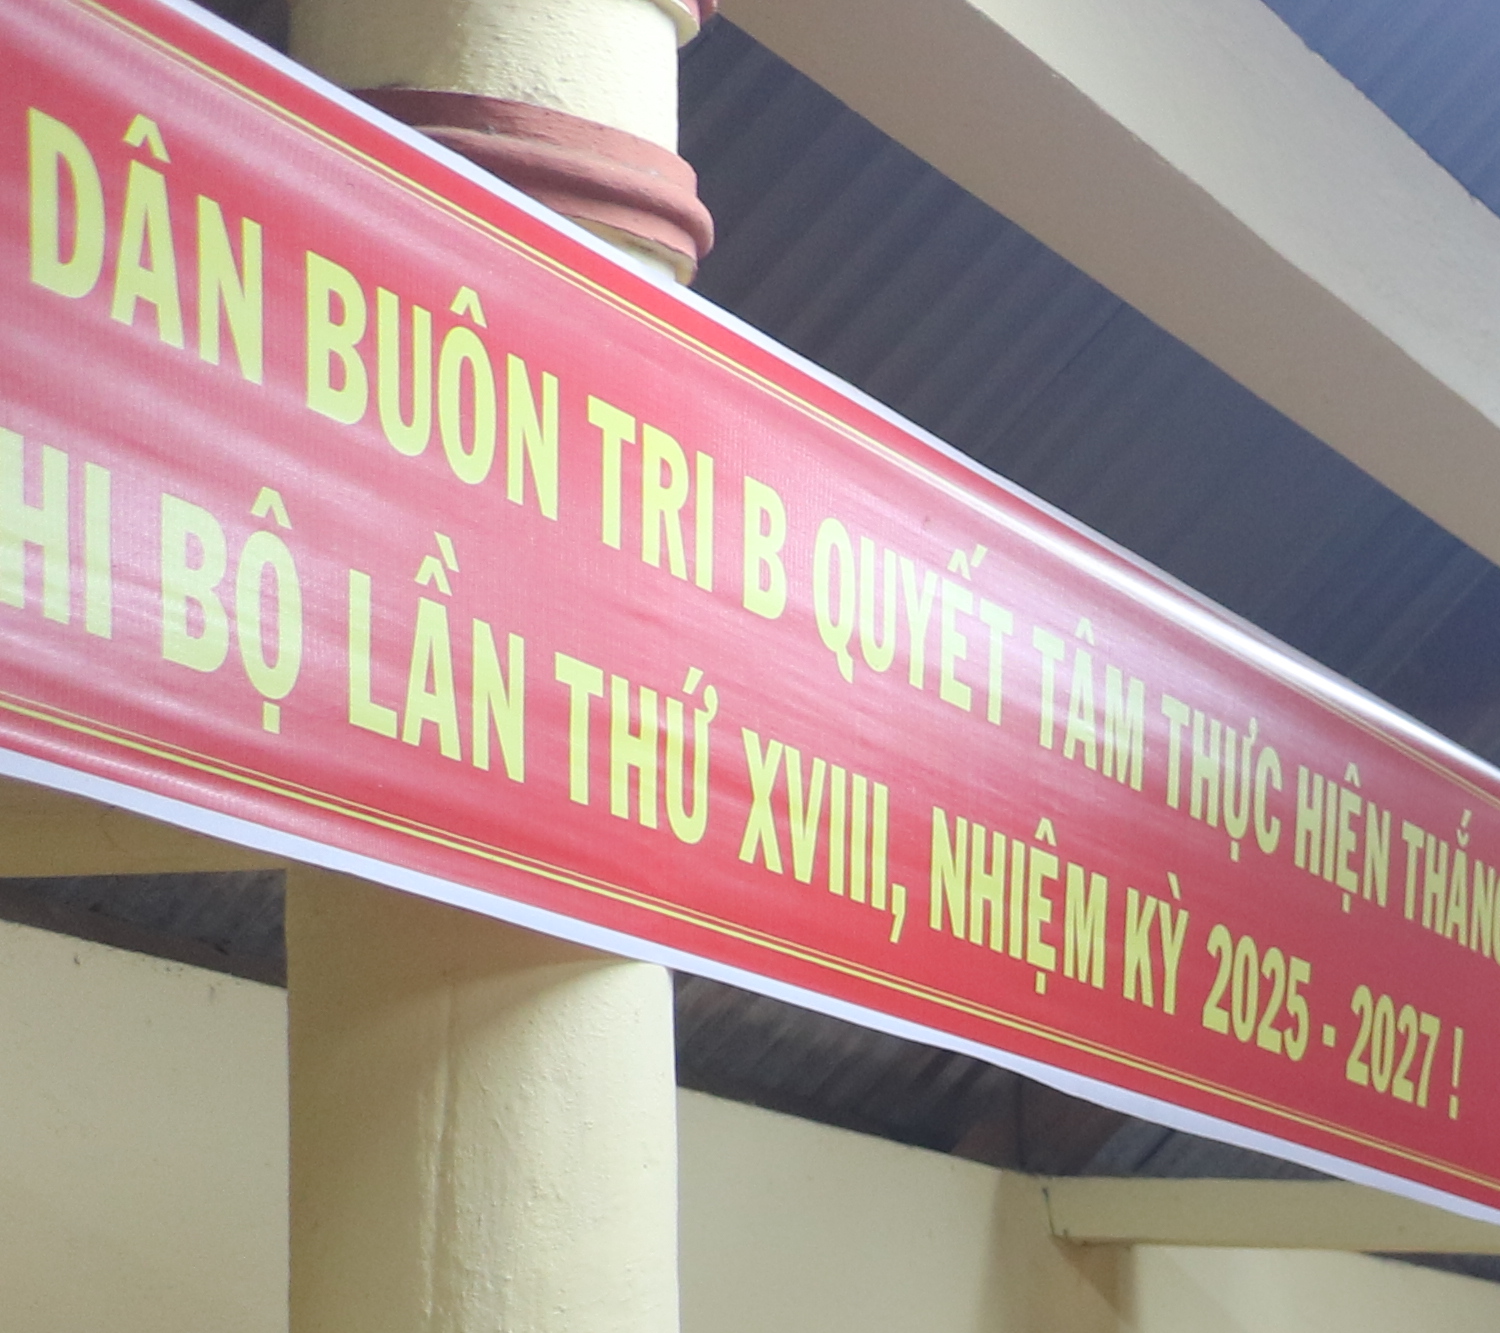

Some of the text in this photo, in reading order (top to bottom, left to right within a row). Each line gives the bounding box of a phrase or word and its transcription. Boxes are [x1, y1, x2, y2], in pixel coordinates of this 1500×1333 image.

[28, 106, 263, 386] DÂN
[305, 249, 559, 522] BUÔN
[587, 394, 714, 593] TRI
[743, 475, 787, 620] B
[812, 515, 1013, 727] QUYẾT
[1031, 619, 1145, 793] TÂM
[1161, 692, 1284, 865] THỰC
[1294, 761, 1390, 914] HIỆN
[161, 487, 303, 734] BỘ
[348, 532, 525, 784] LẦN
[554, 667, 719, 845] THỨ
[739, 728, 908, 944] XVIII,
[930, 806, 1107, 995] NHIỆM
[1123, 872, 1190, 1016] KỲ
[1203, 923, 1312, 1062] 2025
[1346, 985, 1442, 1109] 2027
